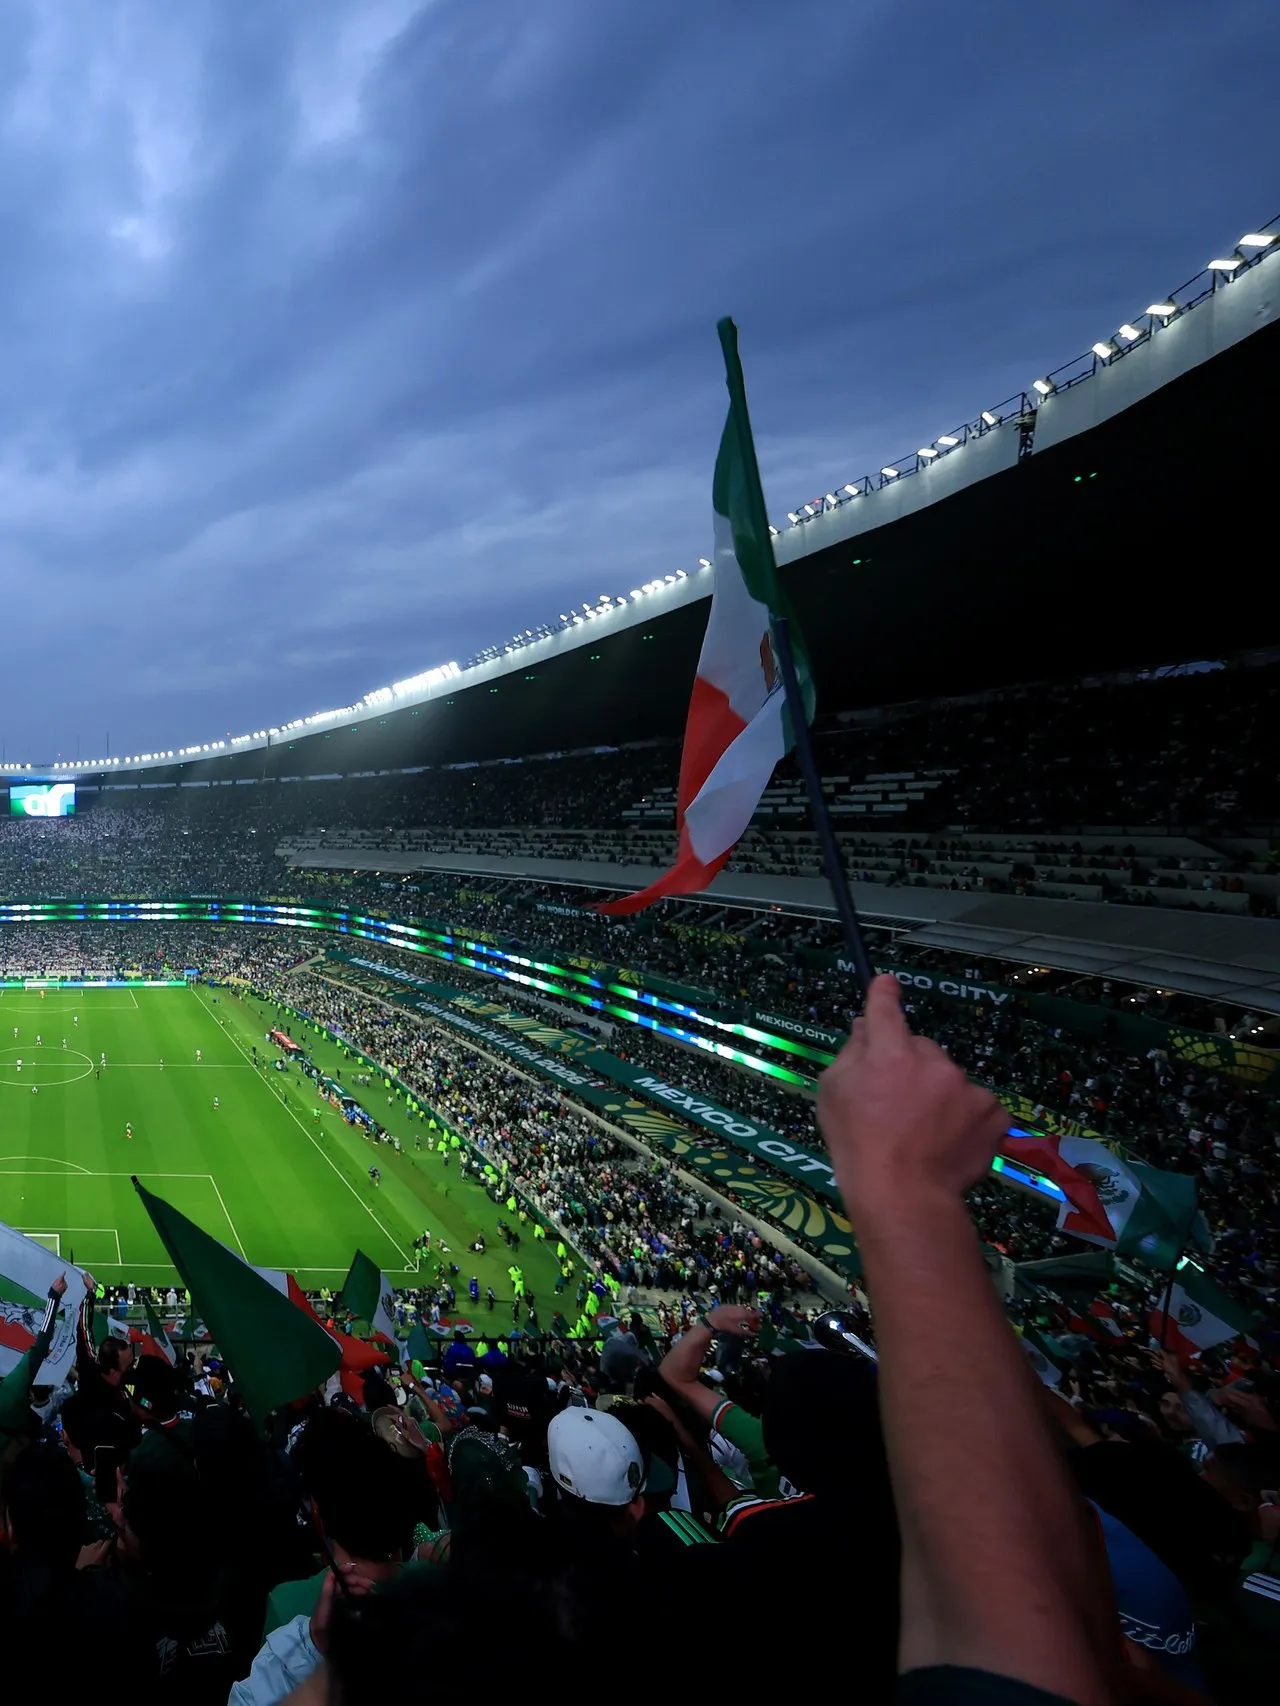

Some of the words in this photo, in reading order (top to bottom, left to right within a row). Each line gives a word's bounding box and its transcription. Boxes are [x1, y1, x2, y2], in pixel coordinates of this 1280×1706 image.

[349, 957, 396, 974] MEXICO
[938, 981, 1008, 1006] CITY
[755, 1012, 803, 1033] MEXICO
[805, 1028, 837, 1045] CITY
[480, 1031, 502, 1040] DE
[494, 1037, 516, 1048] LA
[509, 1045, 542, 1061] FIFA
[535, 1059, 588, 1085] 2026
[633, 1076, 758, 1138] MEXICO
